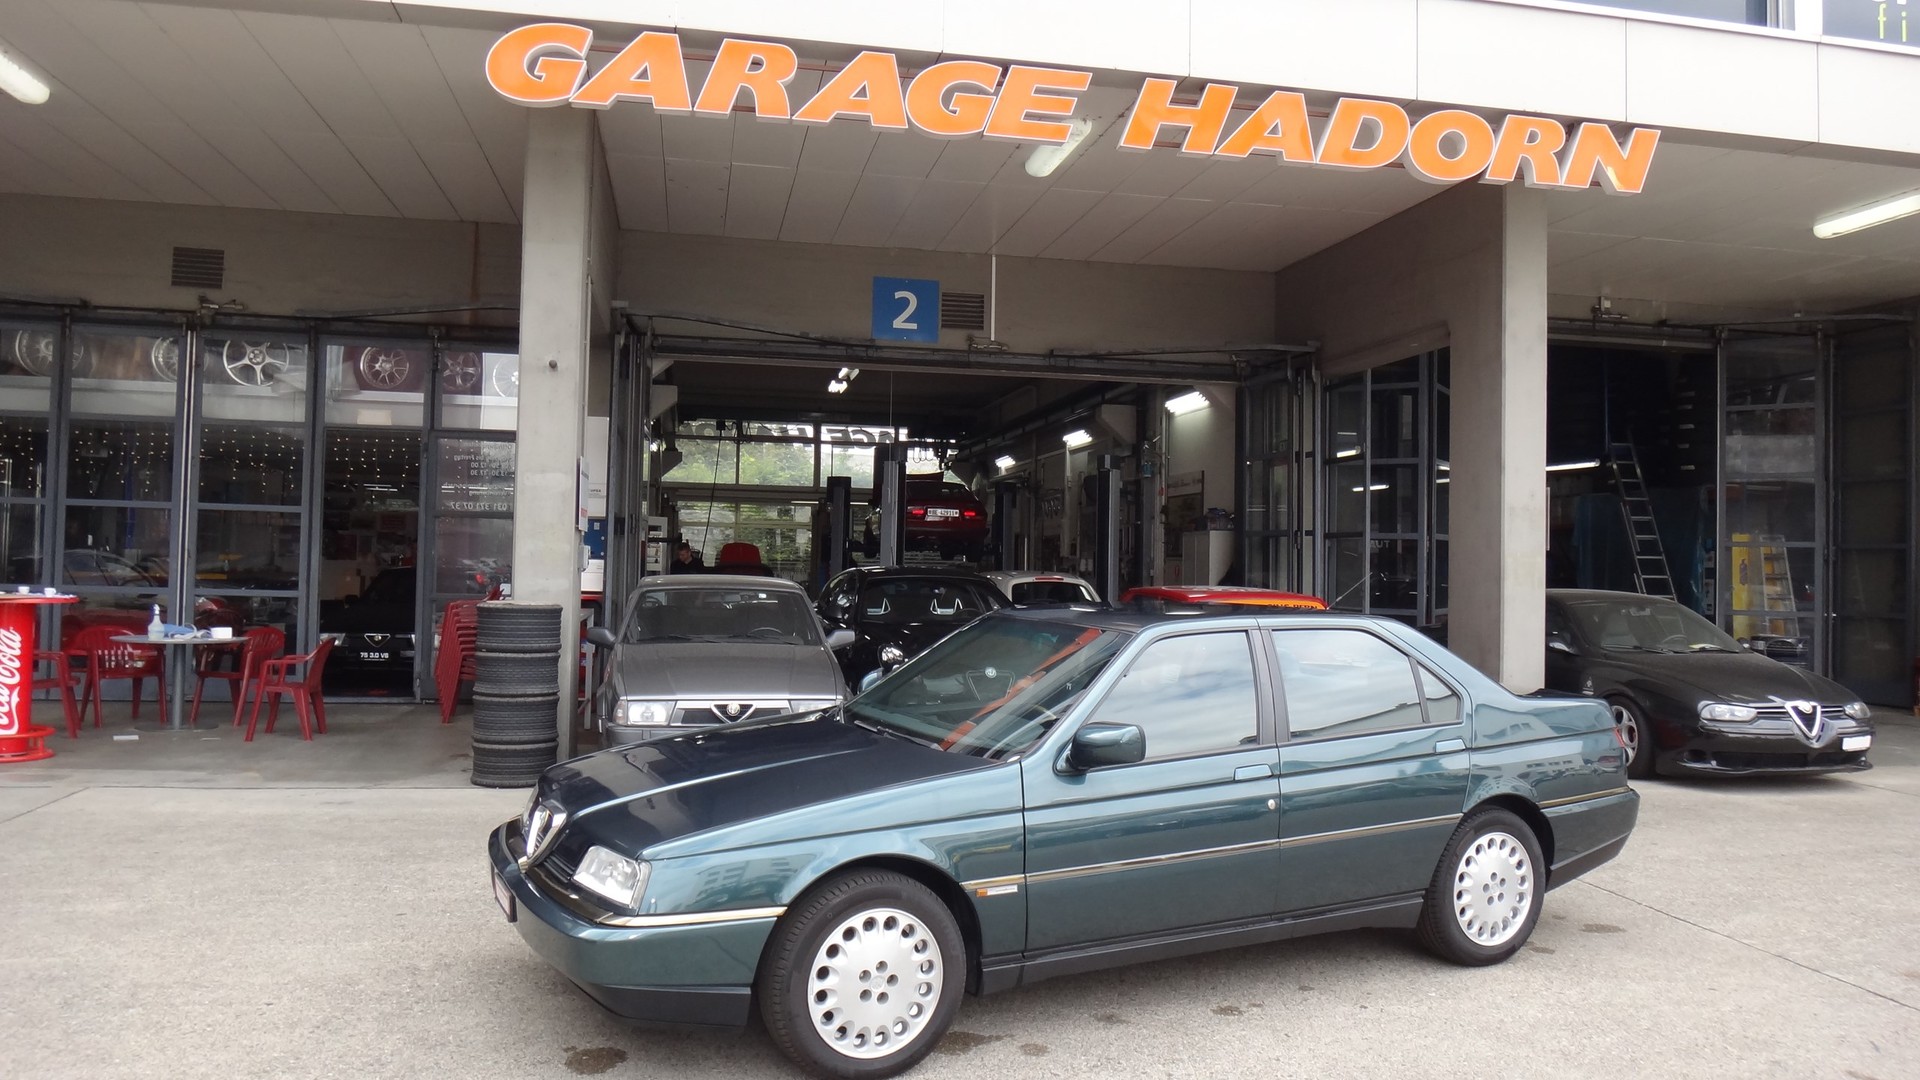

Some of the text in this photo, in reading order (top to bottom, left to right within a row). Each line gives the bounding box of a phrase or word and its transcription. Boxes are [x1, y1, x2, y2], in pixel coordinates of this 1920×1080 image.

[486, 23, 1661, 195] GARAGE HADORN
[893, 290, 918, 330] 2
